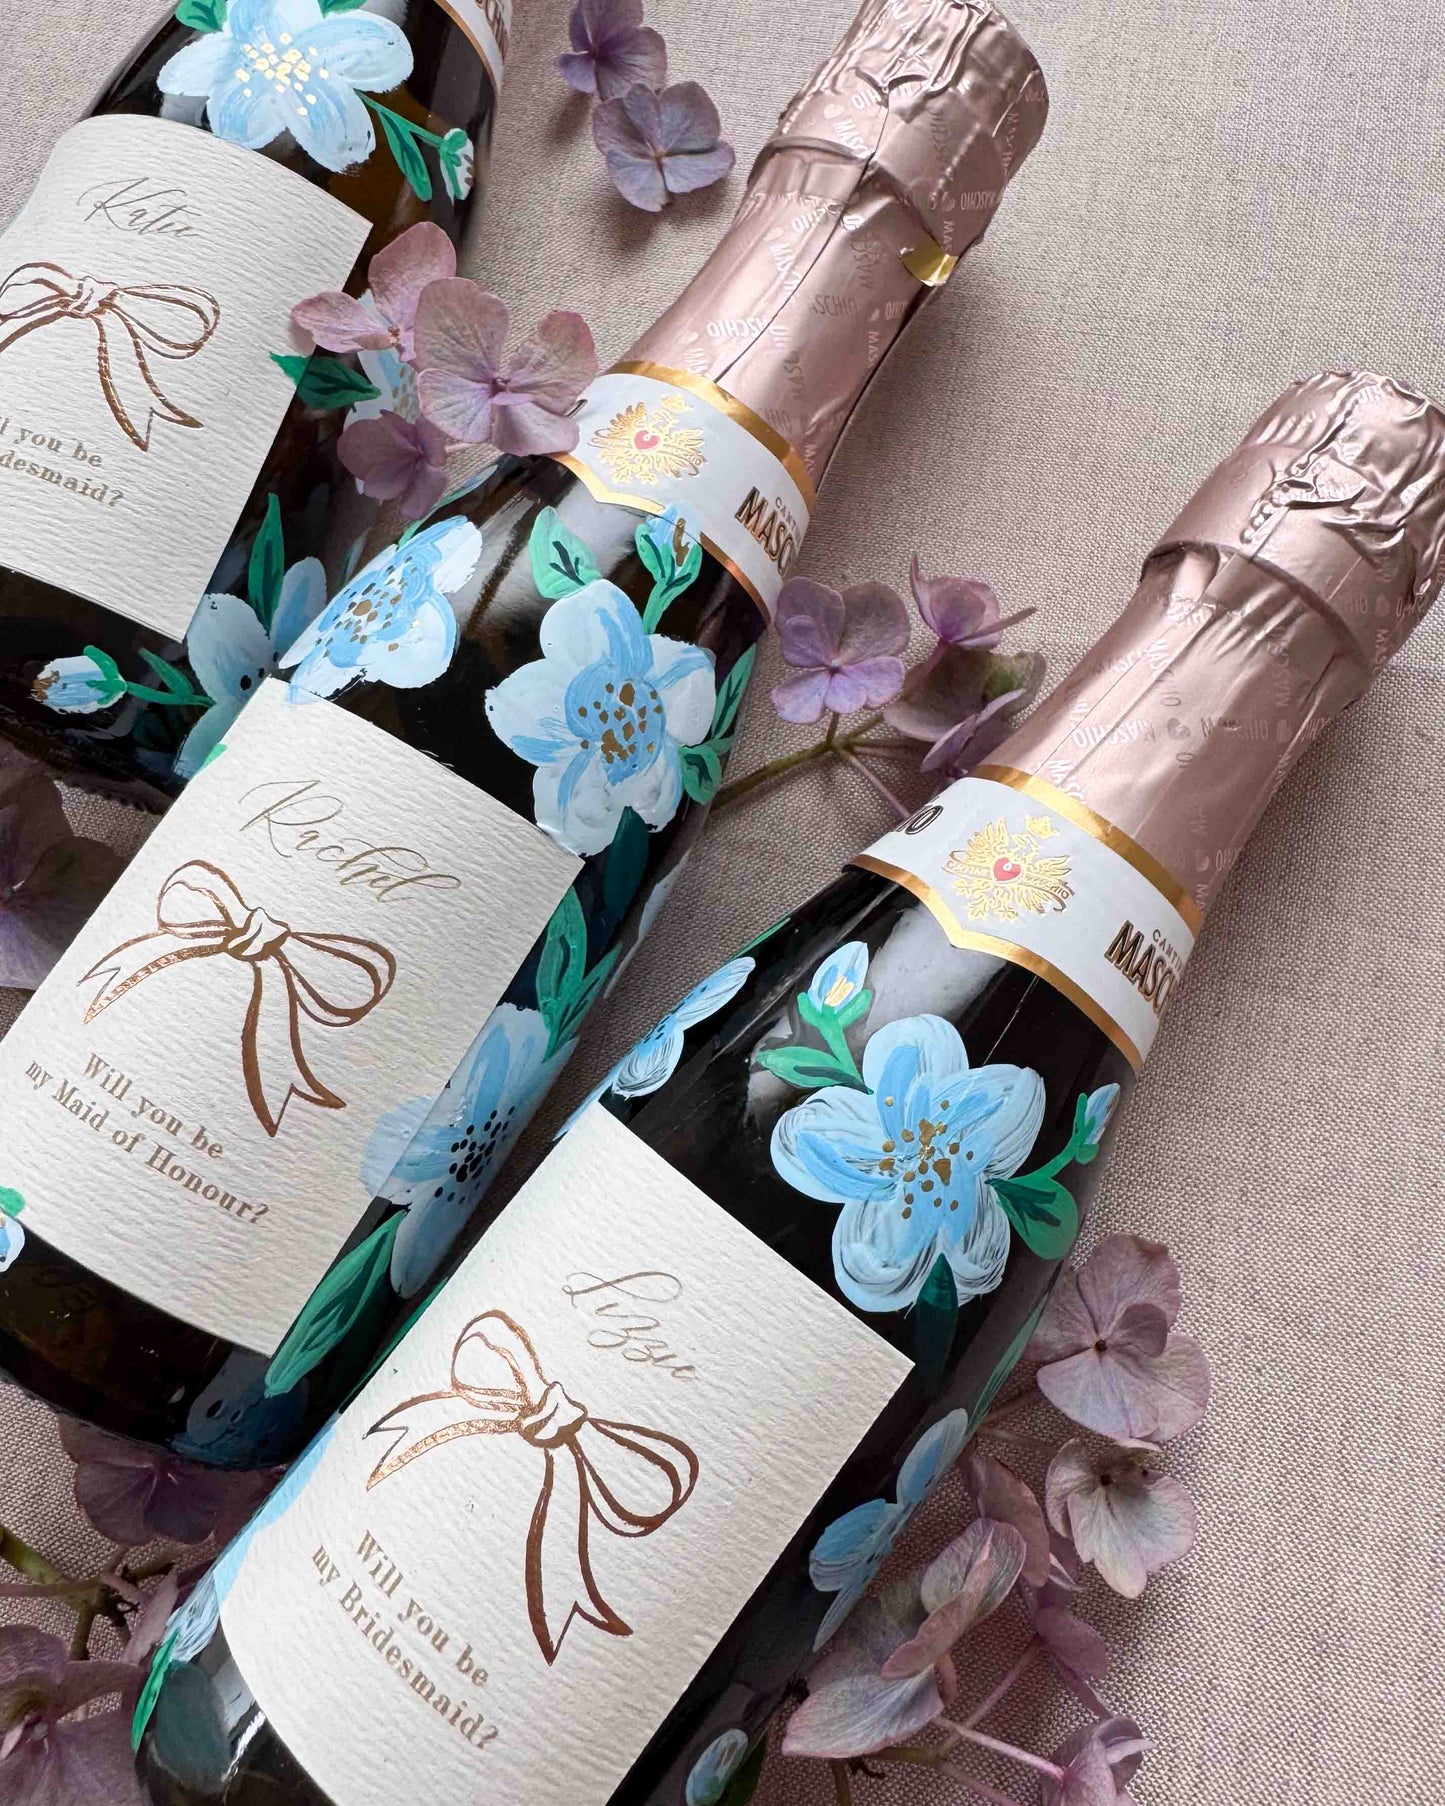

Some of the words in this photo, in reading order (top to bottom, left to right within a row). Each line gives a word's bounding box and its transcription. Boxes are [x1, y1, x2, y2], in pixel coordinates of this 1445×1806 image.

[13, 428, 62, 452] you
[72, 438, 102, 467] be
[25, 1060, 54, 1090] my
[51, 1079, 110, 1133] Maid
[112, 1129, 147, 1154] of
[144, 1141, 270, 1224] Honour?
[82, 1052, 132, 1102] Will
[131, 1096, 184, 1137] you
[190, 1125, 224, 1159] be
[311, 1544, 341, 1587] my
[338, 1579, 500, 1750] Bridesmaid?
[356, 1529, 404, 1598] Will
[397, 1598, 450, 1653] you
[455, 1642, 490, 1688] be
